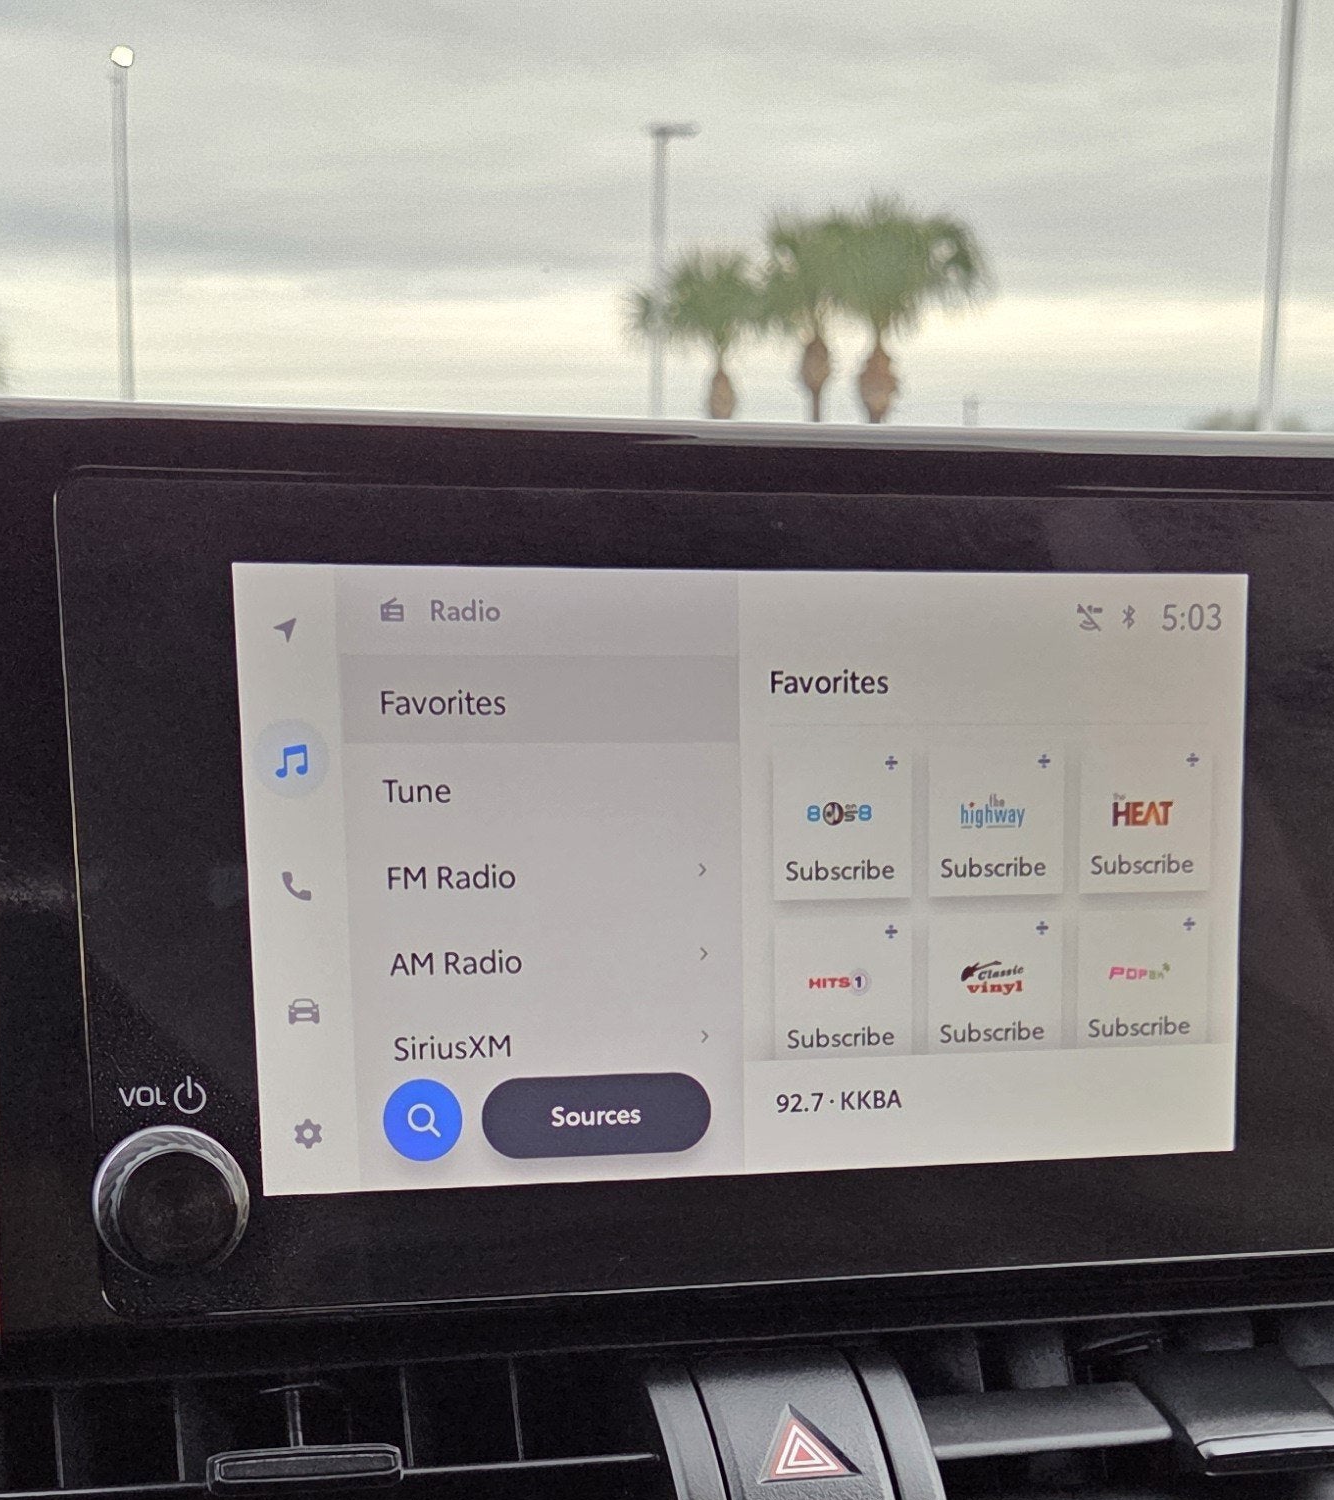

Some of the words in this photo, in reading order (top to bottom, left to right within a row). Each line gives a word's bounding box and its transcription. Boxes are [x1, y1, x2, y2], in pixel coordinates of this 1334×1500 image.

[429, 599, 502, 623] Radio
[1161, 603, 1222, 631] 5:03
[770, 669, 889, 696] Favorites
[380, 688, 507, 716] Favorites
[382, 779, 452, 804] Tune
[960, 802, 1026, 829] highway
[1112, 800, 1174, 827] HEAT
[387, 867, 427, 891] FM
[437, 864, 517, 890] Radio
[785, 859, 896, 882] Subscribe
[940, 857, 1047, 880] Subscribe
[1090, 854, 1195, 877] Subscribe
[390, 951, 435, 977] AM
[444, 949, 523, 976] Radio
[977, 965, 1025, 981] Classic
[808, 976, 851, 989] HITS
[966, 980, 1024, 996] vinyl
[786, 1026, 896, 1049] Subscribe
[939, 1021, 1046, 1045] Subscribe
[1087, 1016, 1192, 1039] Subscribe
[393, 1034, 512, 1062] SiriusXM
[118, 1086, 167, 1107] VOL
[776, 1092, 824, 1113] 92.7
[840, 1089, 903, 1111] KKBA
[551, 1105, 642, 1128] Sources
